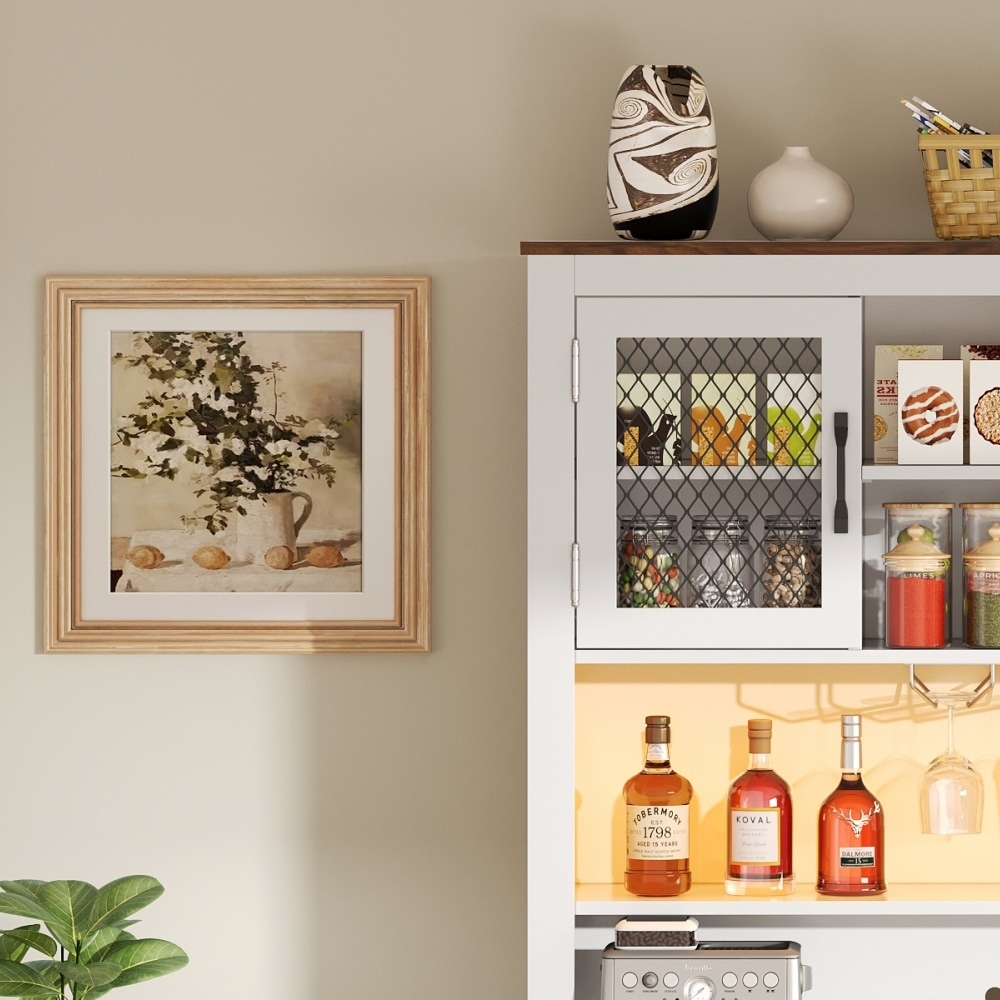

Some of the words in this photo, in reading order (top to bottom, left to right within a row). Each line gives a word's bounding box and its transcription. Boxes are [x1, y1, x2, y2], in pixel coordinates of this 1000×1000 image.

[633, 806, 682, 826] TOBERMORY
[736, 816, 771, 824] KOVAL
[643, 826, 672, 839] 1798
